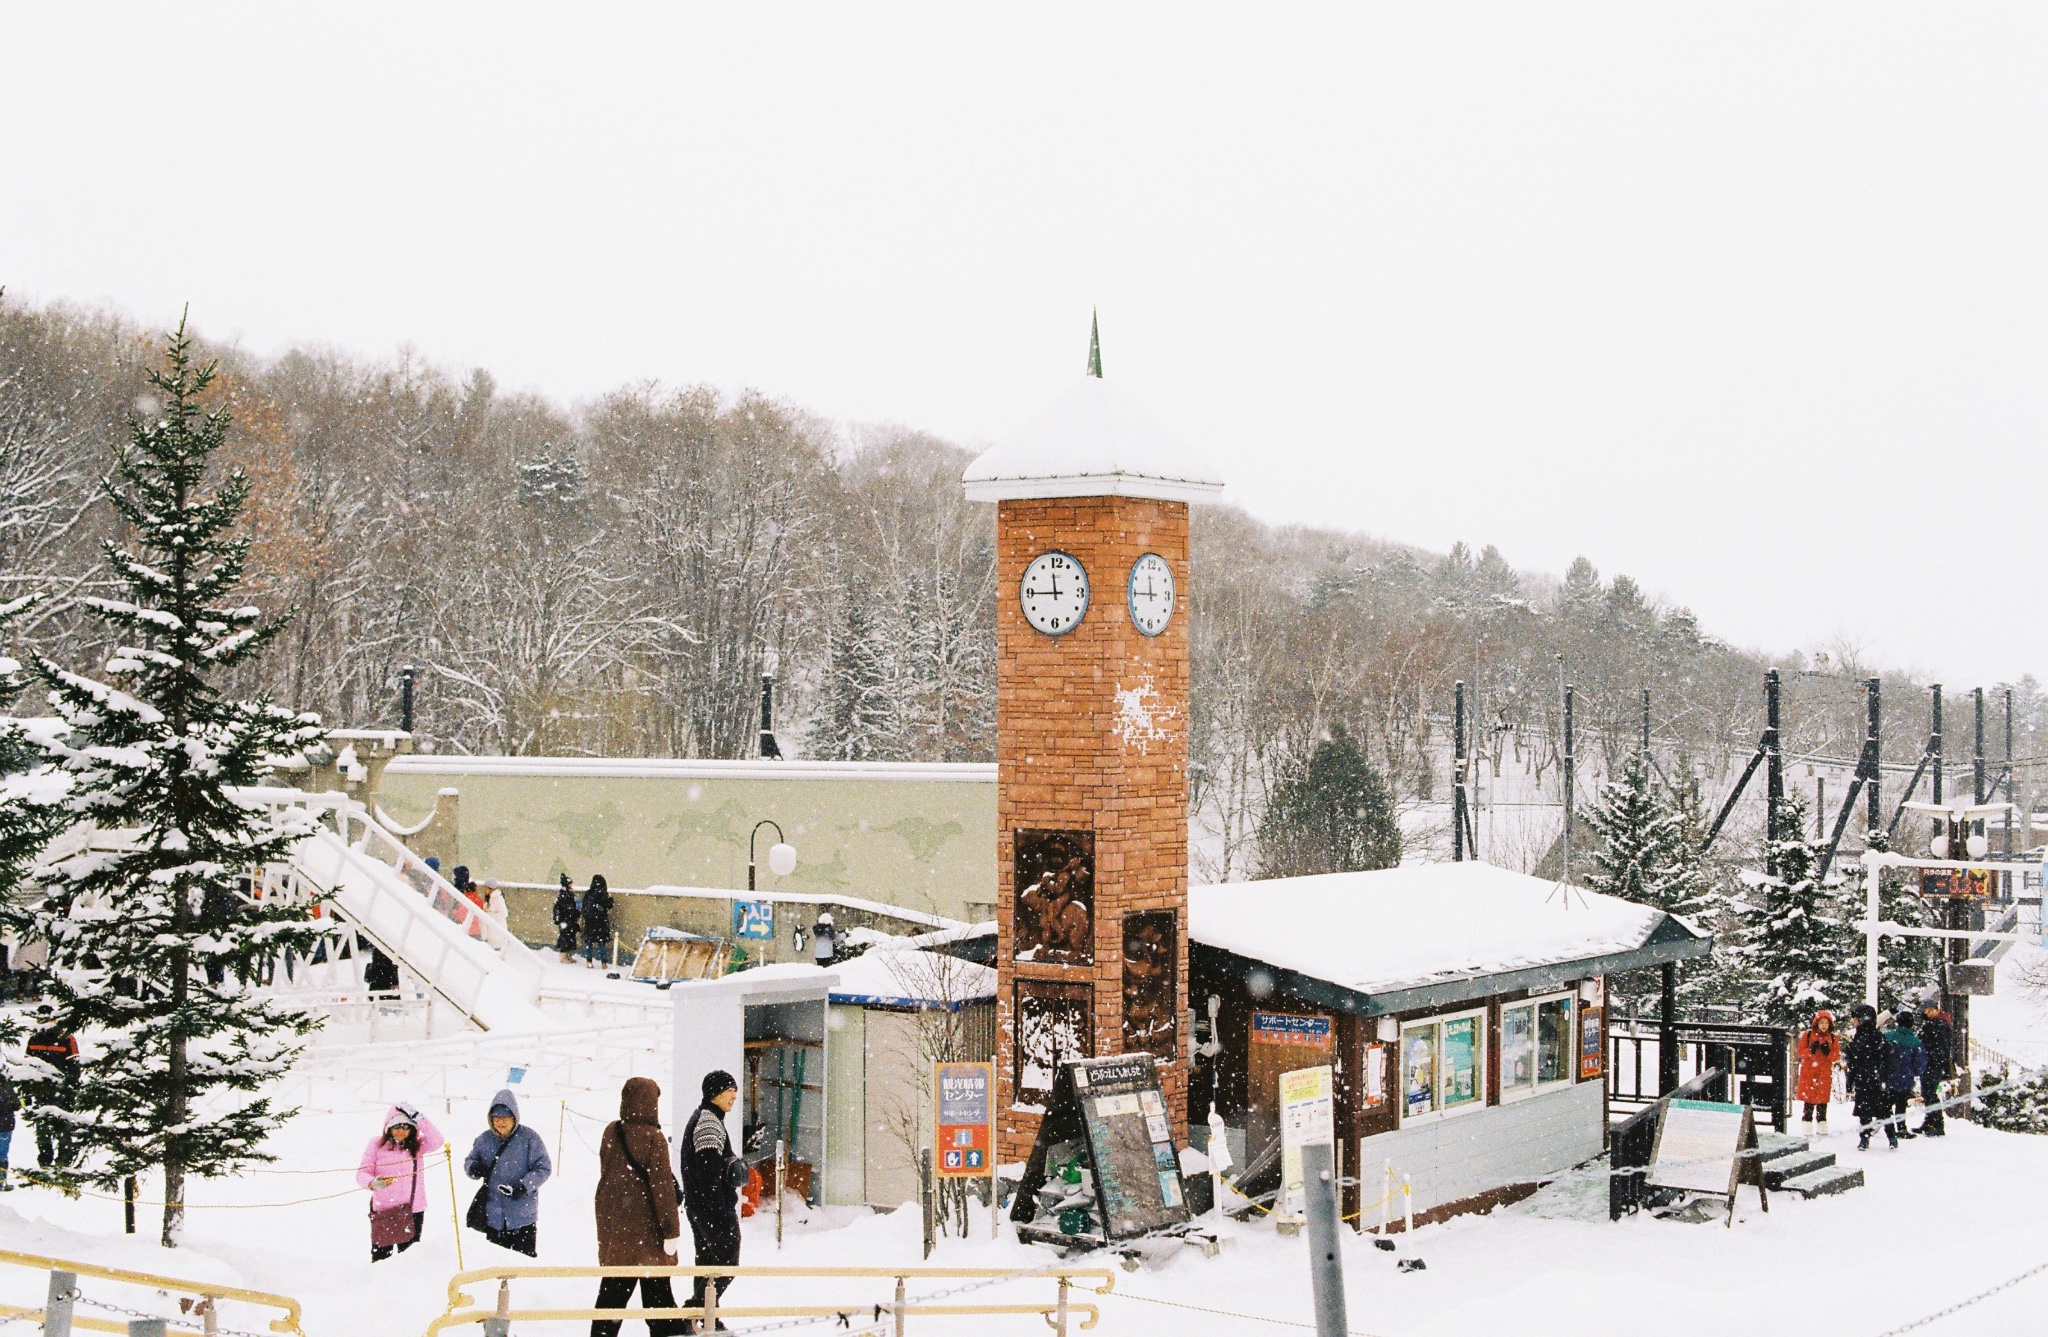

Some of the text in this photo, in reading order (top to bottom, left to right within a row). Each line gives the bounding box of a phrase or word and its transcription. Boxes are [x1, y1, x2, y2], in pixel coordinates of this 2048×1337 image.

[1051, 557, 1063, 569] 12
[1147, 558, 1156, 570] 12
[1026, 587, 1034, 599] 9
[1076, 587, 1084, 598] 3
[1164, 590, 1170, 601] 3
[1051, 617, 1059, 629] 6
[1147, 618, 1153, 630] 6
[748, 904, 772, 920] 入口
[1261, 1016, 1322, 1027] サポートセンター
[943, 1078, 985, 1090] 観光情報
[944, 1090, 984, 1101] センター
